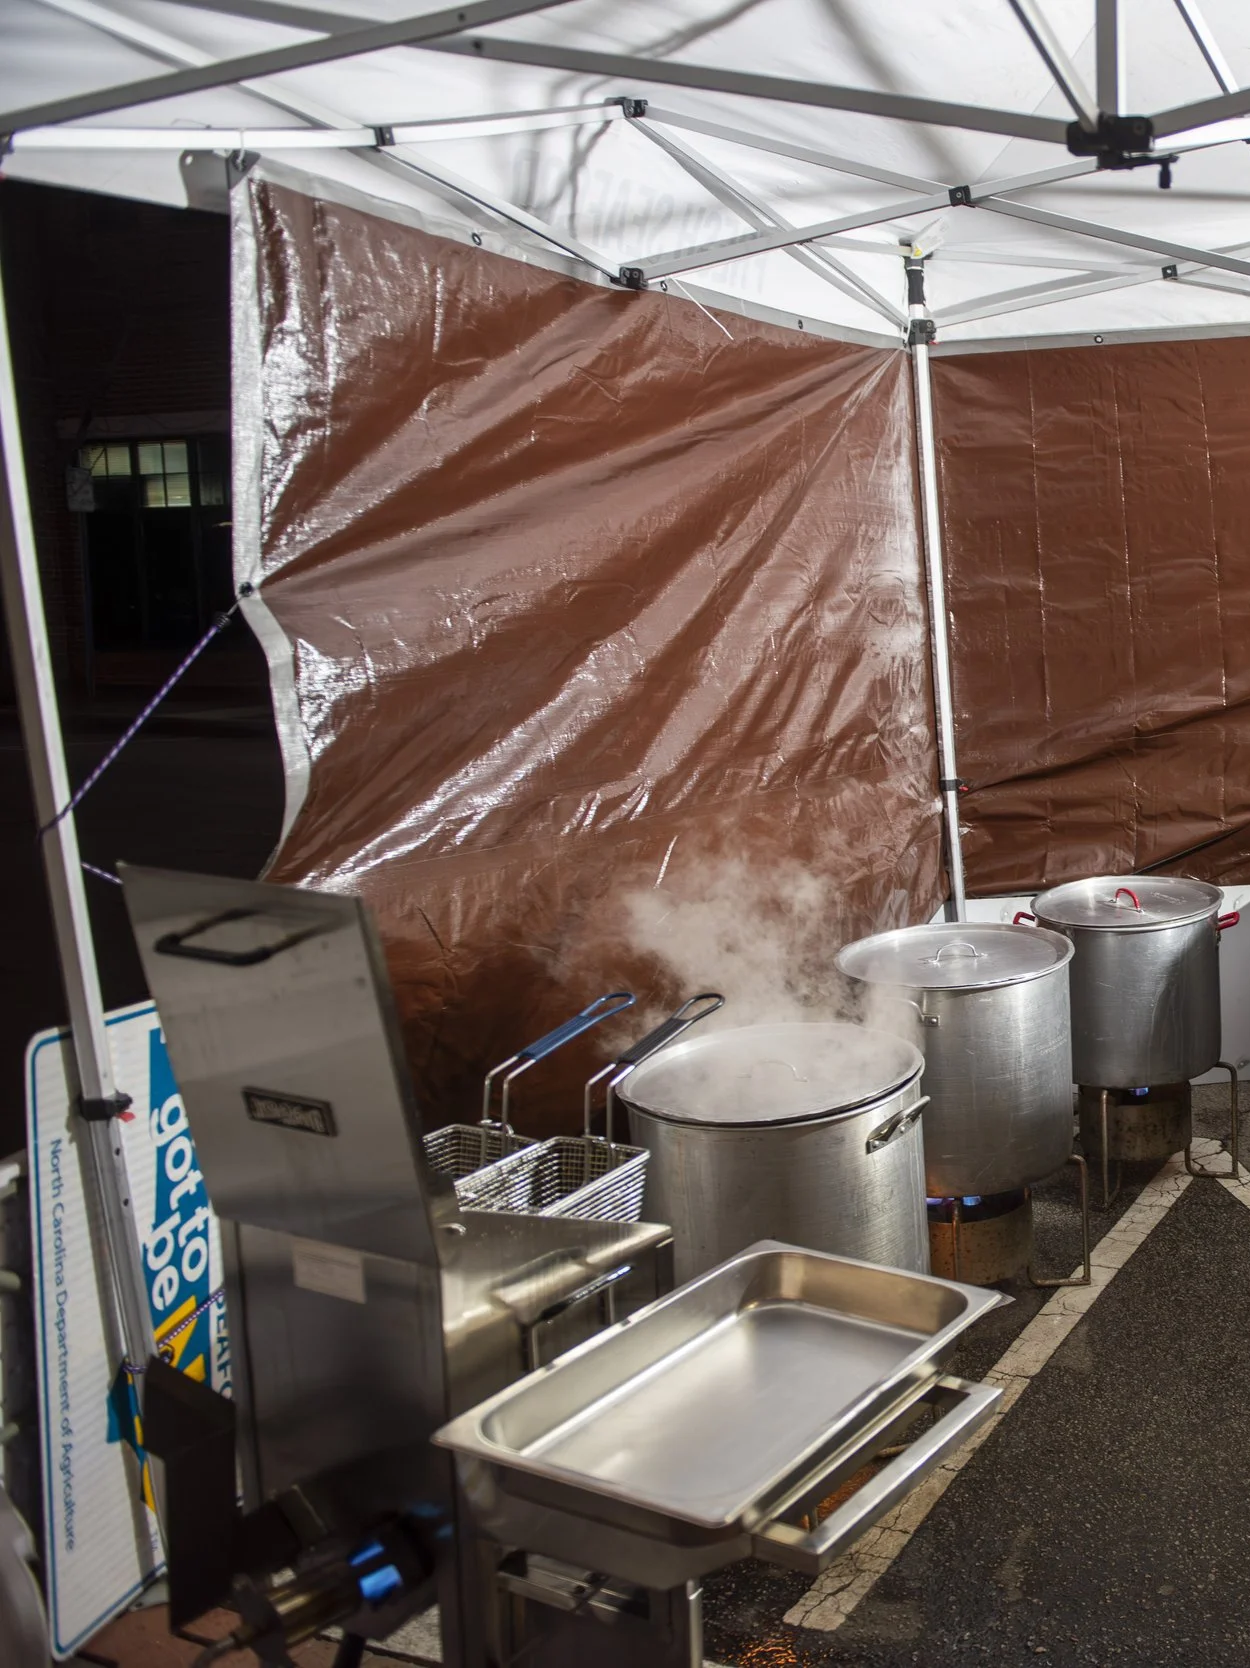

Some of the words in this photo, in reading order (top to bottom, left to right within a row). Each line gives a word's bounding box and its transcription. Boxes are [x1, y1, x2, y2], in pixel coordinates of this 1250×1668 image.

[50, 1138, 65, 1199] North
[150, 1093, 204, 1211] got
[52, 1202, 66, 1287] Carolina
[142, 1210, 181, 1312] be
[178, 1205, 211, 1283] to
[54, 1289, 71, 1415] Department
[60, 1417, 74, 1438] of
[59, 1441, 76, 1553] Agriculture
